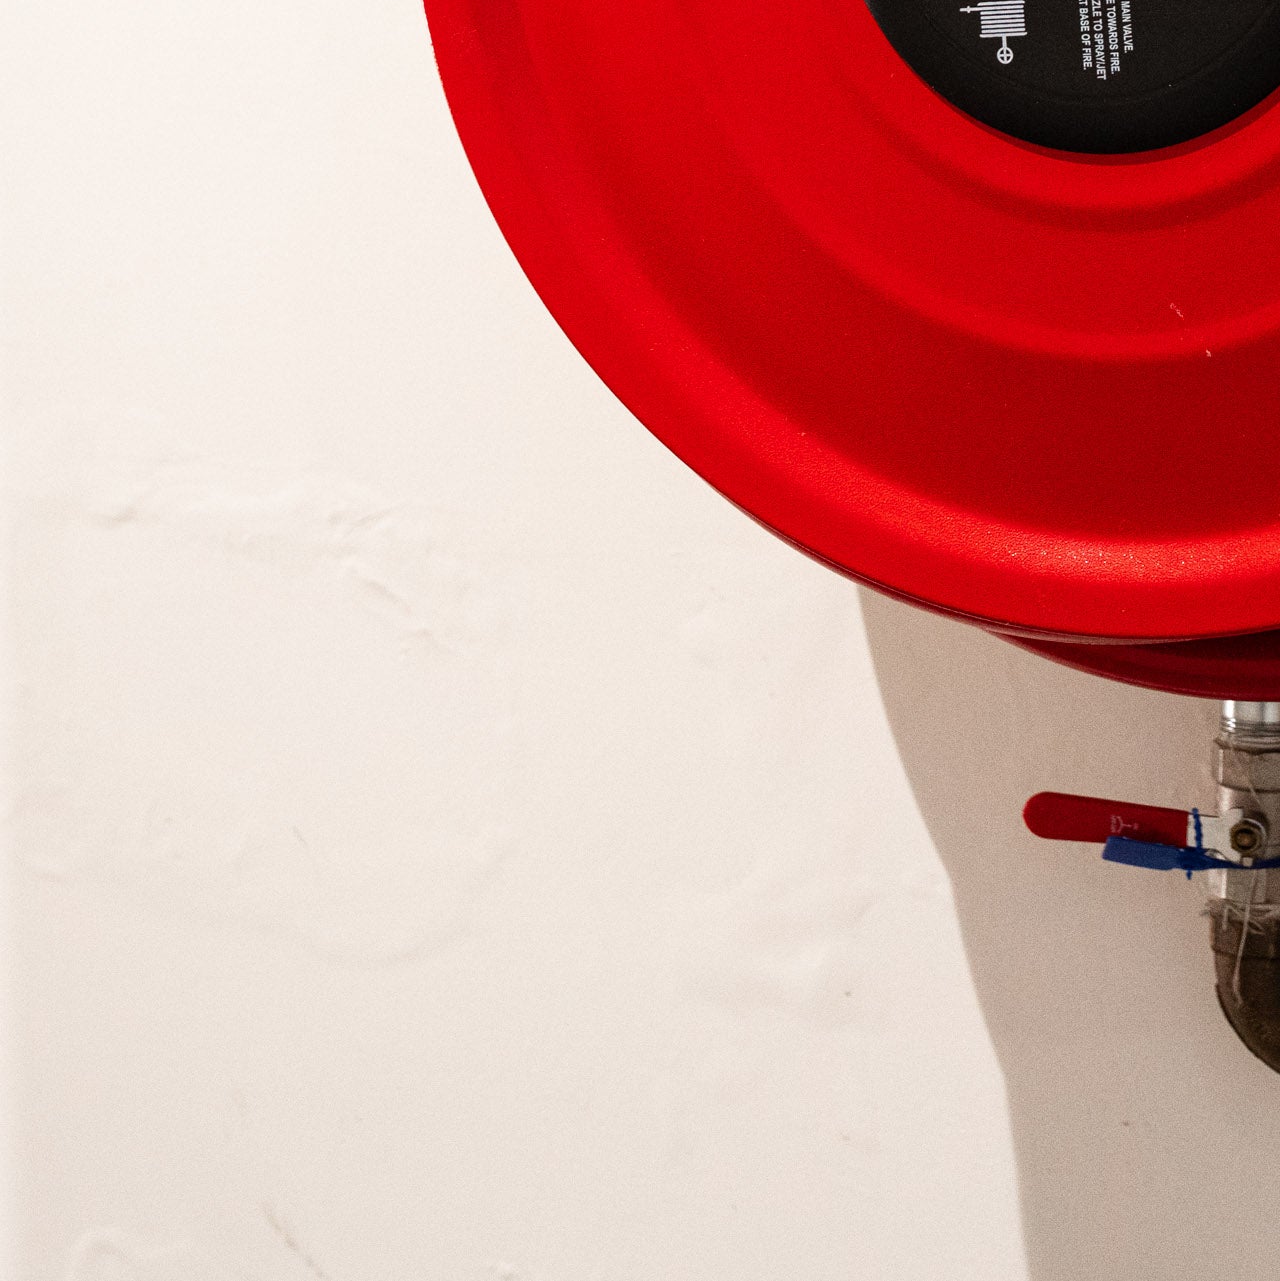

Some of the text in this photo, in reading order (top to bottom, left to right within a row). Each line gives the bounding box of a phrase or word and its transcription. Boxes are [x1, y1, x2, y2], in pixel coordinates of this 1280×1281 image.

[1079, 8, 1090, 32] BASE
[1121, 1, 1131, 22] MAIN
[1093, 19, 1103, 31] TO
[1107, 6, 1118, 50] TOWARDS
[1081, 34, 1091, 45] OF
[1123, 24, 1133, 53] VALVE.
[1082, 48, 1092, 70] FIRE.
[1094, 33, 1106, 80] SPRAY/JET
[1110, 52, 1120, 74] FIRE.
